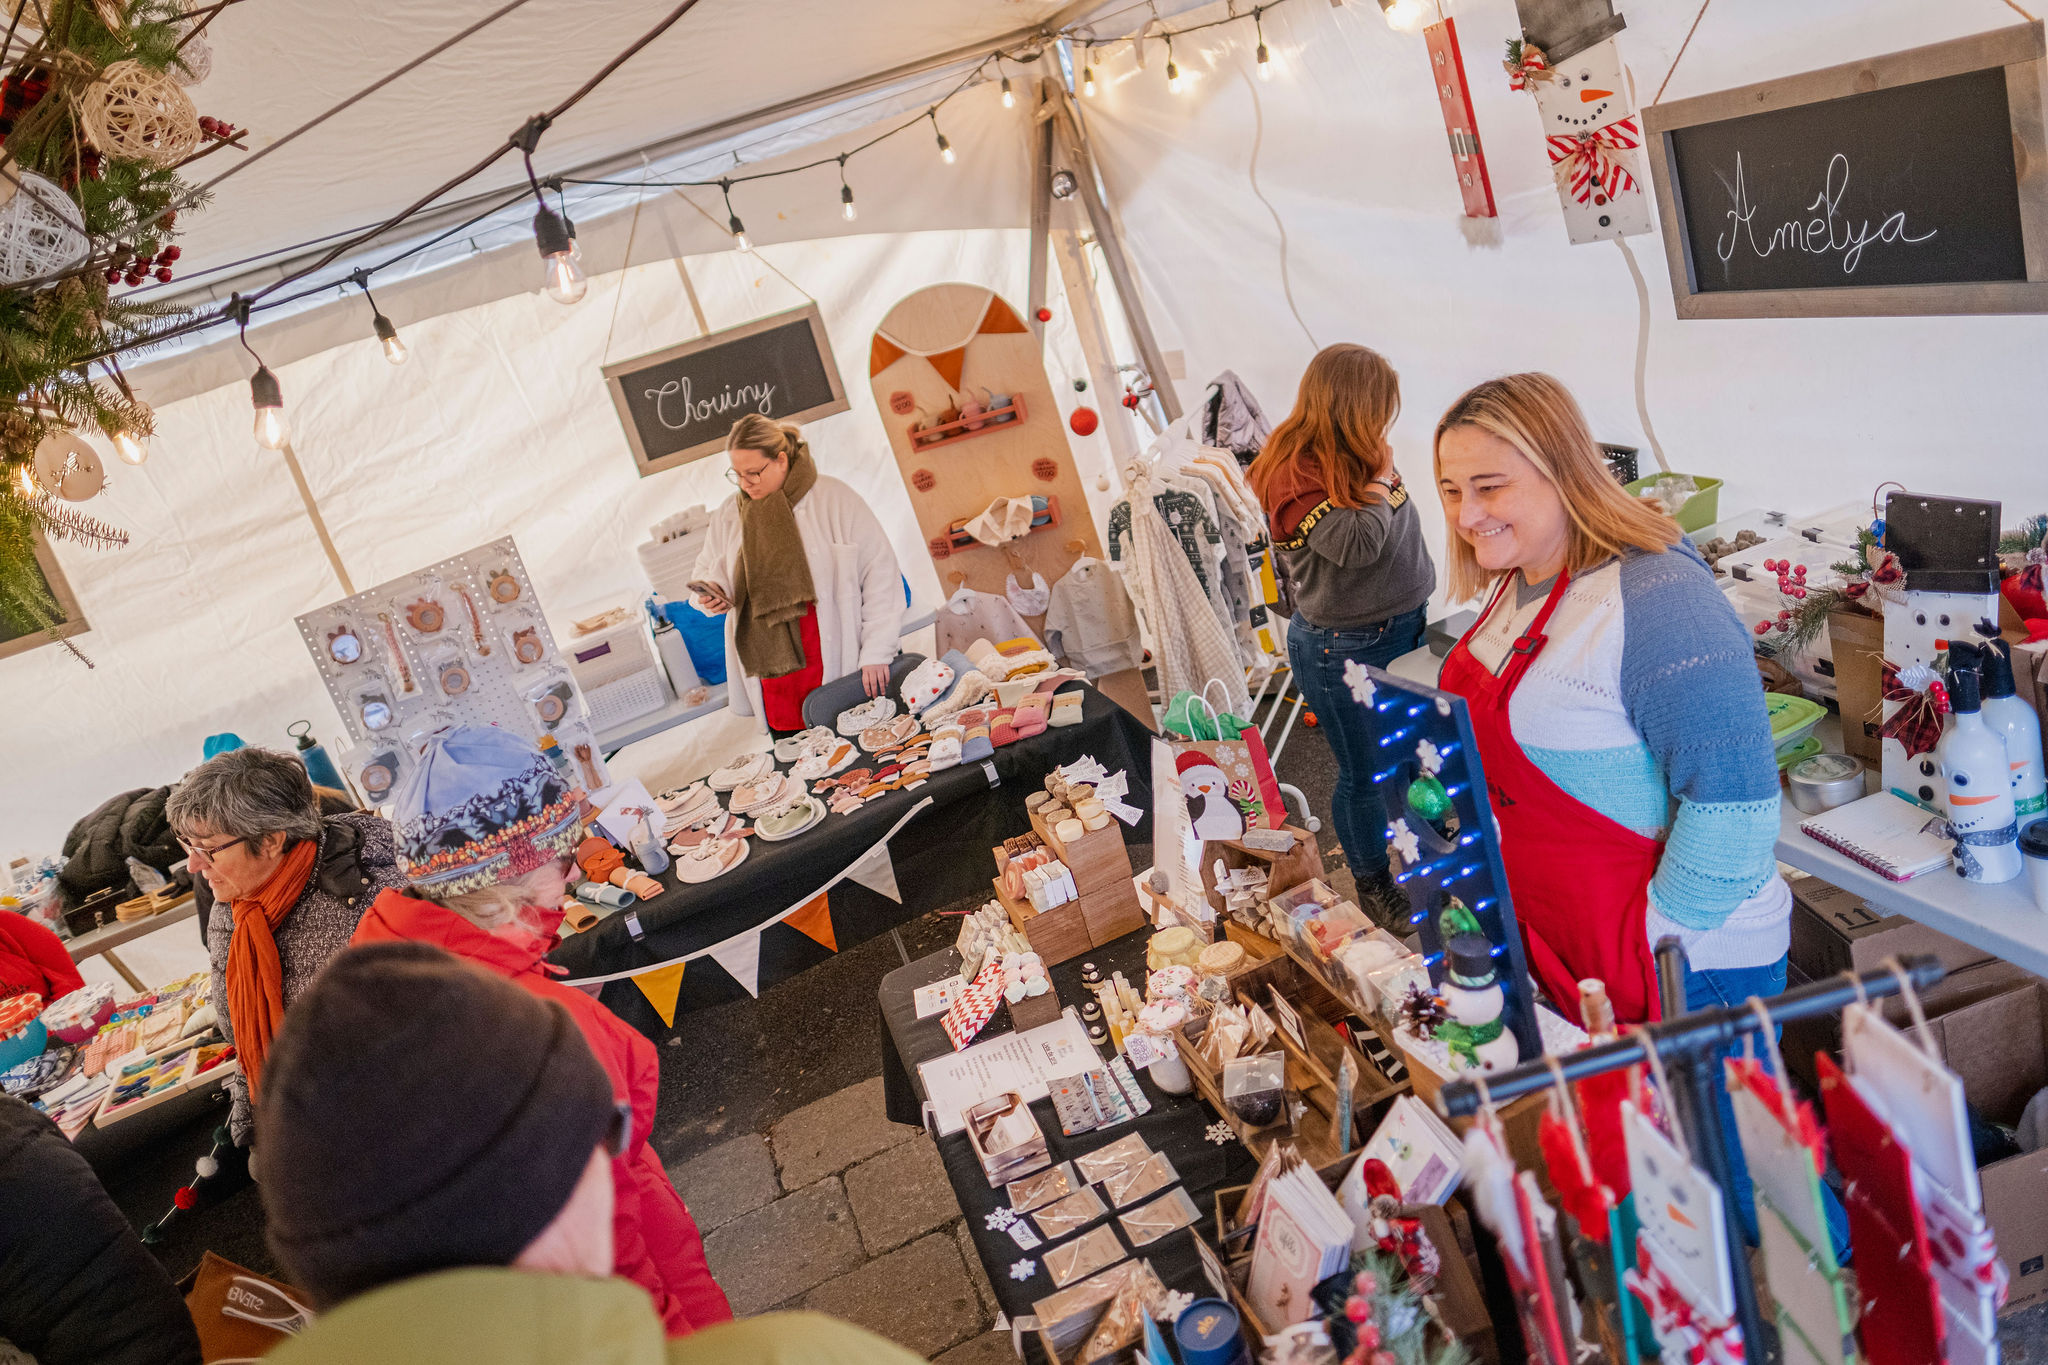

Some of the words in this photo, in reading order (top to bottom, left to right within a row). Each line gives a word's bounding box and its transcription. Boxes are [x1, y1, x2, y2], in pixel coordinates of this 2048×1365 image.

[1434, 50, 1446, 67] HO
[1440, 84, 1453, 100] HO
[1462, 172, 1473, 188] HO
[1298, 498, 1335, 536] POTT
